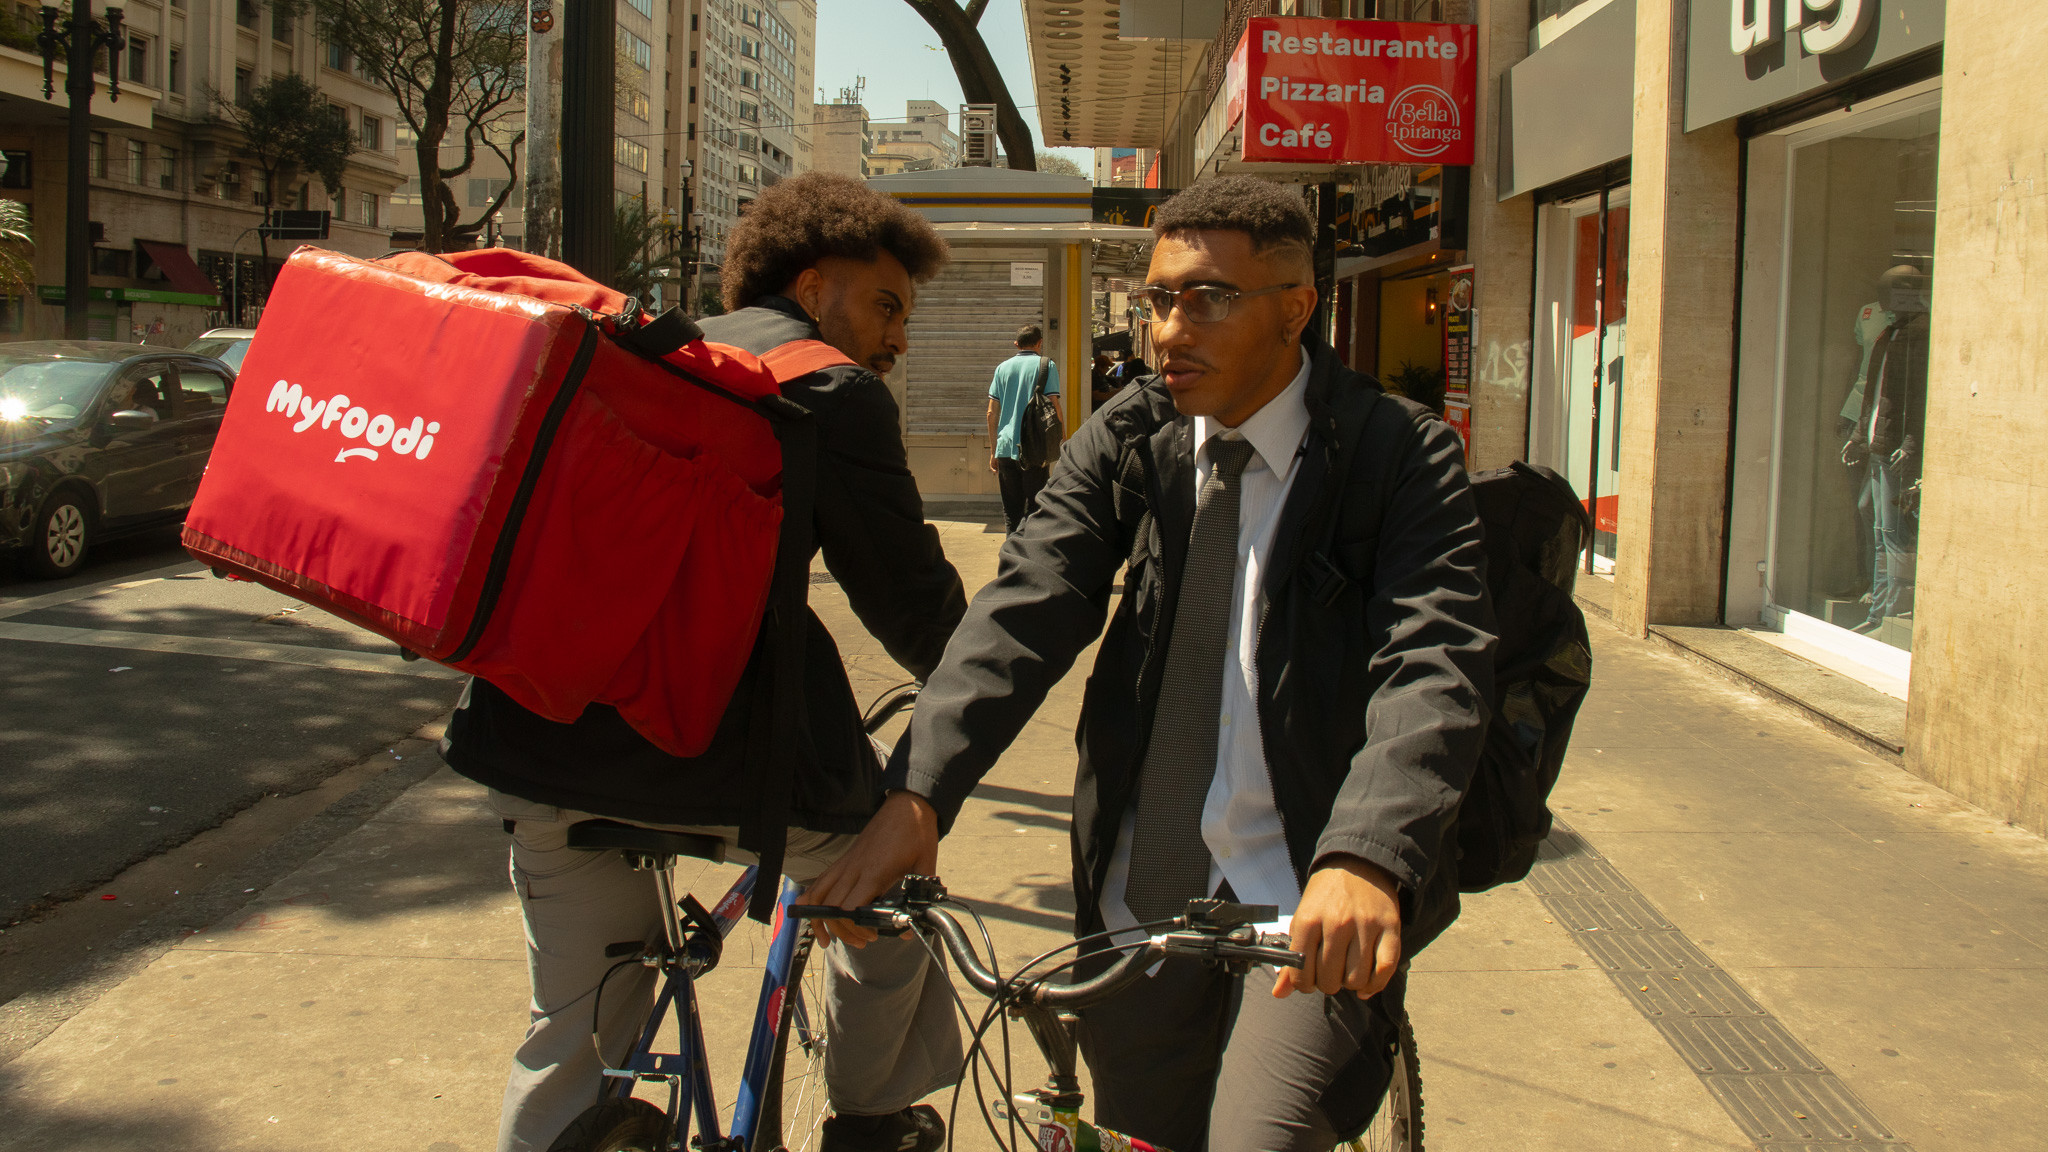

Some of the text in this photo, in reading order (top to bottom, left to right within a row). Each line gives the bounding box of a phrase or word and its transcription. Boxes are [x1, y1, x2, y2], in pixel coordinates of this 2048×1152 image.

[1262, 30, 1459, 60] Restaurante
[1260, 76, 1385, 104] Pizzaria
[1401, 99, 1448, 125] Bella
[1259, 122, 1333, 149] Café
[1385, 121, 1462, 143] Ipiranga
